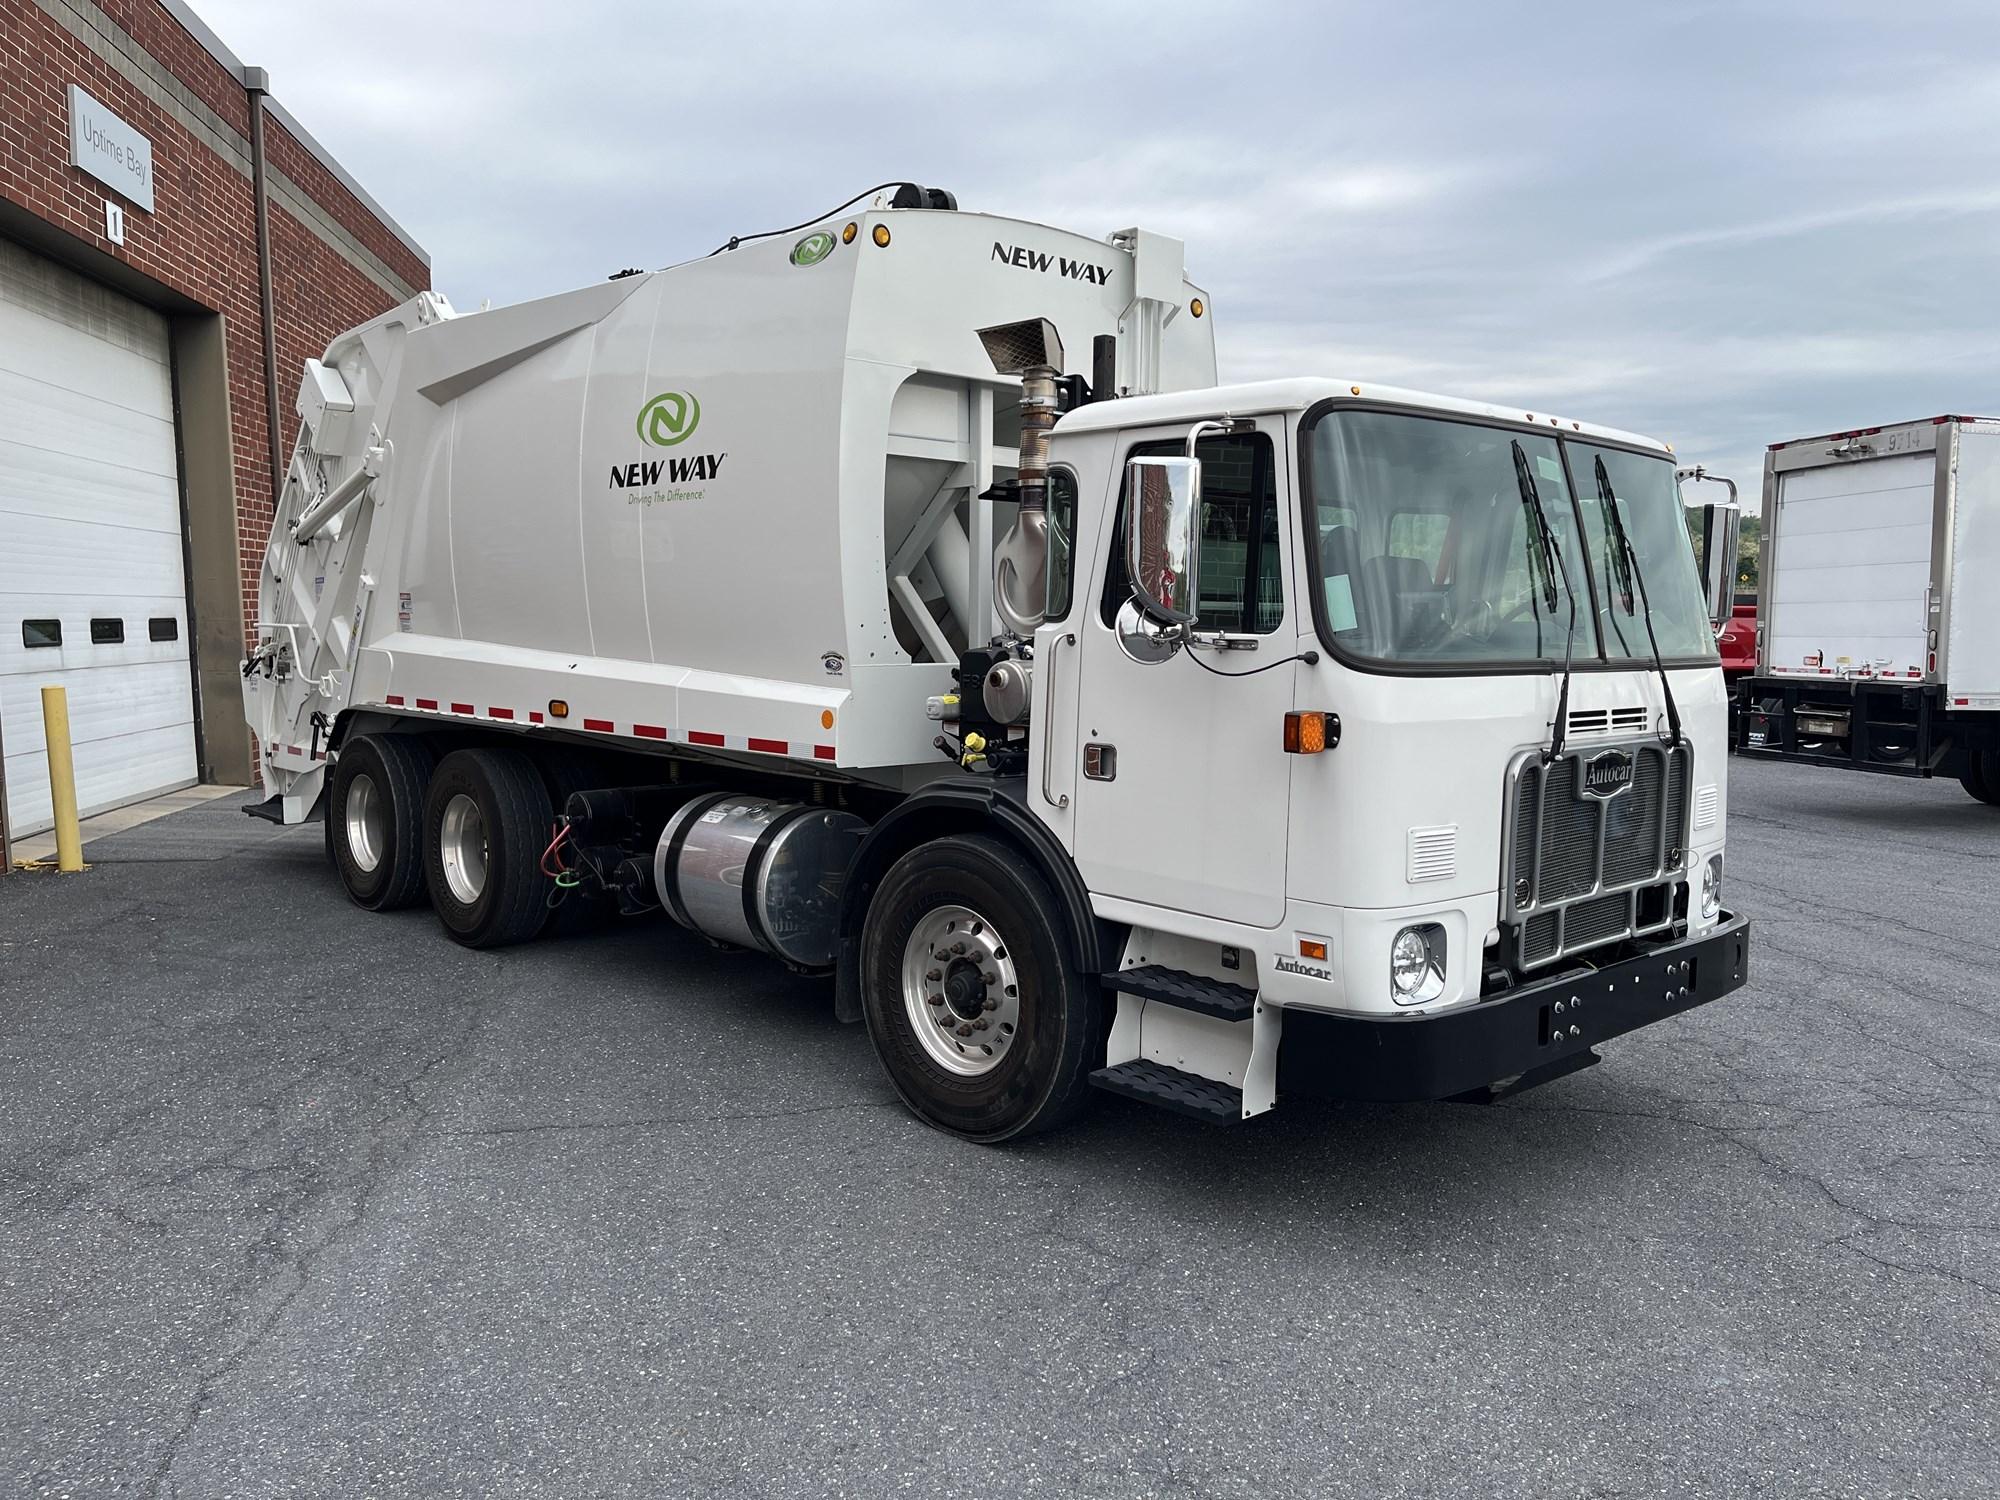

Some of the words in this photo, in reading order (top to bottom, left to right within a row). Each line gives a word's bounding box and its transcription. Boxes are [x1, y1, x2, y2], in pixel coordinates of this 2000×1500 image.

[82, 114, 123, 165] Uptime
[126, 147, 146, 186] Bay
[111, 210, 119, 237] 1
[991, 240, 1055, 273] NEW
[1059, 256, 1113, 286] WAY
[608, 459, 665, 489] NEW
[668, 452, 726, 483] WAY
[628, 493, 652, 507] Driving
[654, 489, 666, 503] The
[1585, 762, 1632, 786] Autocar
[1274, 956, 1333, 981] Autocar
